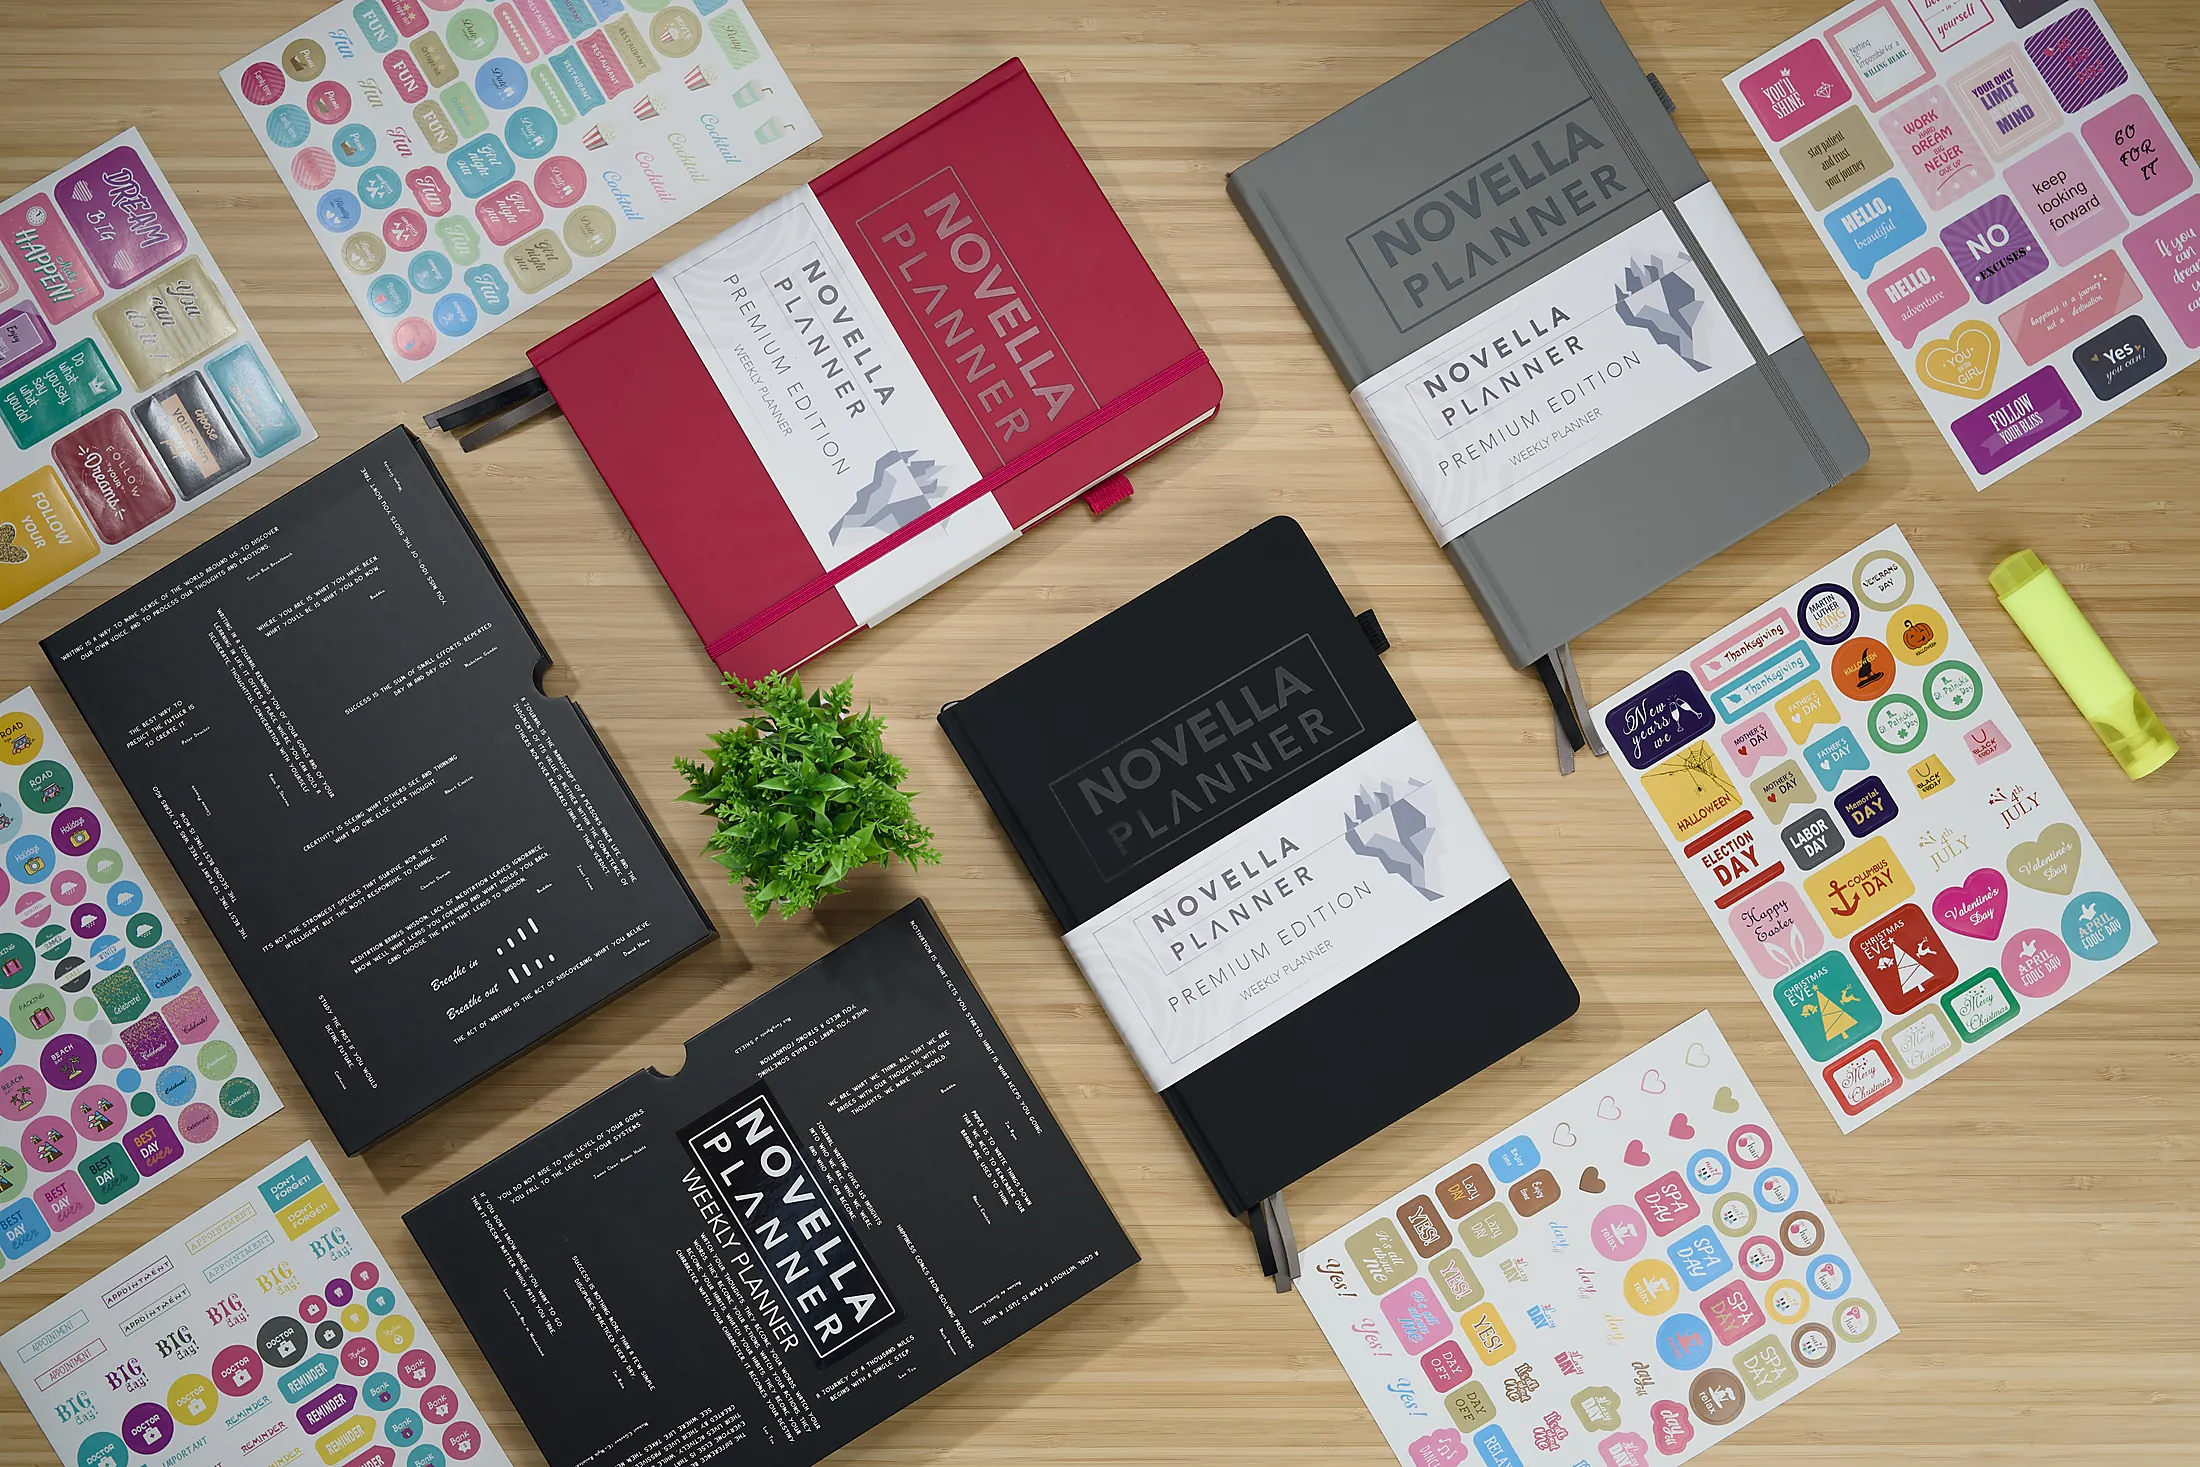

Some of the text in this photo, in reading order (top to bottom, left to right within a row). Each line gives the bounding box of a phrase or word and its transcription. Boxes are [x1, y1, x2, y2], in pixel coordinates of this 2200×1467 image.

[1936, 2, 1976, 39] yourself
[590, 42, 619, 85] RESTAURANT
[1848, 39, 1871, 57] Nothing
[1863, 49, 1908, 78] WILLING HEART.
[392, 59, 418, 93] FUN
[1971, 67, 2014, 98] YOUR ONLY
[1771, 91, 1805, 119] SHINE
[1980, 79, 2019, 110] LIMIT
[1903, 109, 1938, 135] WORK
[1917, 125, 1936, 139] HARD
[1995, 104, 2035, 134] MIND
[2113, 123, 2137, 146] GO
[1807, 130, 1845, 159] stay patient
[1911, 125, 1953, 155] DREAM
[1933, 144, 1945, 155] BIG
[2119, 138, 2156, 167] FOR
[1820, 147, 1850, 171] and trust
[1824, 159, 1866, 190] your journey
[1924, 144, 1963, 173] NEVER
[1938, 159, 1961, 177] GIVE UP
[2140, 157, 2160, 181] IT
[602, 169, 644, 222] Cocktail
[1373, 120, 1603, 267] NOVELLA
[2032, 170, 2067, 195] keep
[2037, 181, 2088, 215] looking
[101, 166, 169, 250] DREAM
[505, 190, 530, 217] Girl
[1840, 196, 1892, 233] HELLO,
[2049, 194, 2100, 231] forward
[85, 208, 117, 242] BIG
[1403, 164, 1626, 307] PLANNER
[1853, 218, 1896, 250] beautiful
[1965, 223, 2010, 261] NO
[14, 222, 74, 304] HAPPEN!
[1979, 247, 2027, 280] EXCUSES
[165, 279, 202, 318] You
[1884, 266, 1936, 303] HELLO,
[148, 295, 175, 327] can
[925, 189, 1075, 421] NOVELLA
[1900, 290, 1945, 321] adventure
[774, 276, 865, 418] PLANNER
[801, 259, 895, 405] NOVELLA
[882, 222, 1030, 449] PLANNER
[1423, 305, 1570, 398] NOVELLA
[1946, 348, 1972, 367] YOU
[2102, 342, 2134, 365] Yes
[2105, 347, 2147, 384] you can!
[723, 273, 850, 476] PREMIUM EDITION
[733, 343, 793, 437] WEEKLY PLANNER
[1441, 335, 1584, 426] PLANNER
[1957, 366, 1986, 387] GIRL
[1438, 350, 1641, 476] PREMIUM EDITION
[1988, 392, 2034, 431] FOLLOW
[1998, 411, 2044, 444] YOUR BLISS
[1508, 407, 1602, 466] WEEKLY PLANNER
[83, 452, 121, 511] Dreams
[105, 444, 141, 498] FOLLOW
[106, 466, 122, 488] YOUR
[21, 514, 46, 549] YOUR
[31, 491, 71, 545] FOLLOW
[1859, 560, 1899, 588] VETERANS
[1878, 577, 1894, 592] DAY
[1806, 593, 1836, 613] MARTIN
[1812, 600, 1839, 621] LUTHER
[1815, 606, 1846, 631] KING
[1724, 624, 1784, 663] Thanksgiving
[128, 699, 183, 736] THE BEST WAY TO
[1620, 696, 1667, 735] New
[1078, 665, 1312, 814] NOVELLA
[1630, 715, 1673, 759] years
[1733, 724, 1766, 746] MOTHER'S
[1749, 730, 1769, 747] DAY
[29, 770, 53, 787] ROAD
[1103, 704, 1337, 856] PLANNER
[1676, 791, 1731, 832] HALLOWEEN
[1844, 788, 1880, 813] Memorial
[1851, 797, 1884, 825] DAY
[1999, 791, 2041, 829] JULY
[59, 816, 85, 835] Holidays
[1789, 818, 1828, 848] LABOR
[1701, 830, 1754, 868] ELECTION
[1803, 834, 1828, 858] DAY
[1713, 845, 1760, 886] DAY
[1846, 858, 1889, 888] COLUMBUS
[1151, 836, 1300, 933] NOVELLA
[1861, 867, 1894, 897] DAY
[1169, 866, 1314, 961] PLANNER
[1741, 898, 1789, 934] Happy
[1944, 886, 2000, 921] Valentine's
[1969, 907, 1995, 926] Day
[1754, 909, 1795, 942] Easter
[1167, 880, 1372, 1012] PREMIUM EDITION
[2017, 948, 2055, 976] APRIL
[429, 958, 479, 992] Breathe in
[1239, 939, 1333, 1001] WEEKLY PLANNER
[2041, 954, 2062, 973] DAY
[1782, 966, 1828, 998] CHRISTMAS
[1786, 985, 1814, 1007] EVE
[445, 982, 500, 1021] Breathe out
[50, 1043, 74, 1062] BEACH
[133, 1127, 157, 1147] BEST
[139, 1140, 159, 1158] DAY
[270, 1174, 297, 1194] DON'T
[272, 1174, 311, 1200] FORGET!
[1447, 1183, 1466, 1201] DAY
[1461, 1175, 1480, 1201] Lazy
[1660, 1183, 1688, 1213] SPA
[736, 1104, 877, 1323] NOVELLA
[1644, 1191, 1674, 1223] DAY
[703, 1125, 844, 1348] PLANNER
[1407, 1205, 1440, 1247] YES!
[1600, 1226, 1619, 1251] relax
[681, 1167, 799, 1353] WEEKLY PLANNER
[1315, 1257, 1357, 1299] Yes!
[45, 1346, 95, 1381] APPOINTMENT
[104, 1357, 145, 1391] BIG
[1430, 1357, 1451, 1381] OFF
[1442, 1350, 1462, 1374] DAY
[125, 1372, 149, 1393] day!
[130, 1413, 160, 1436] DOCTOR
[305, 1393, 347, 1425] REMINDER
[449, 1430, 471, 1446] Bank
